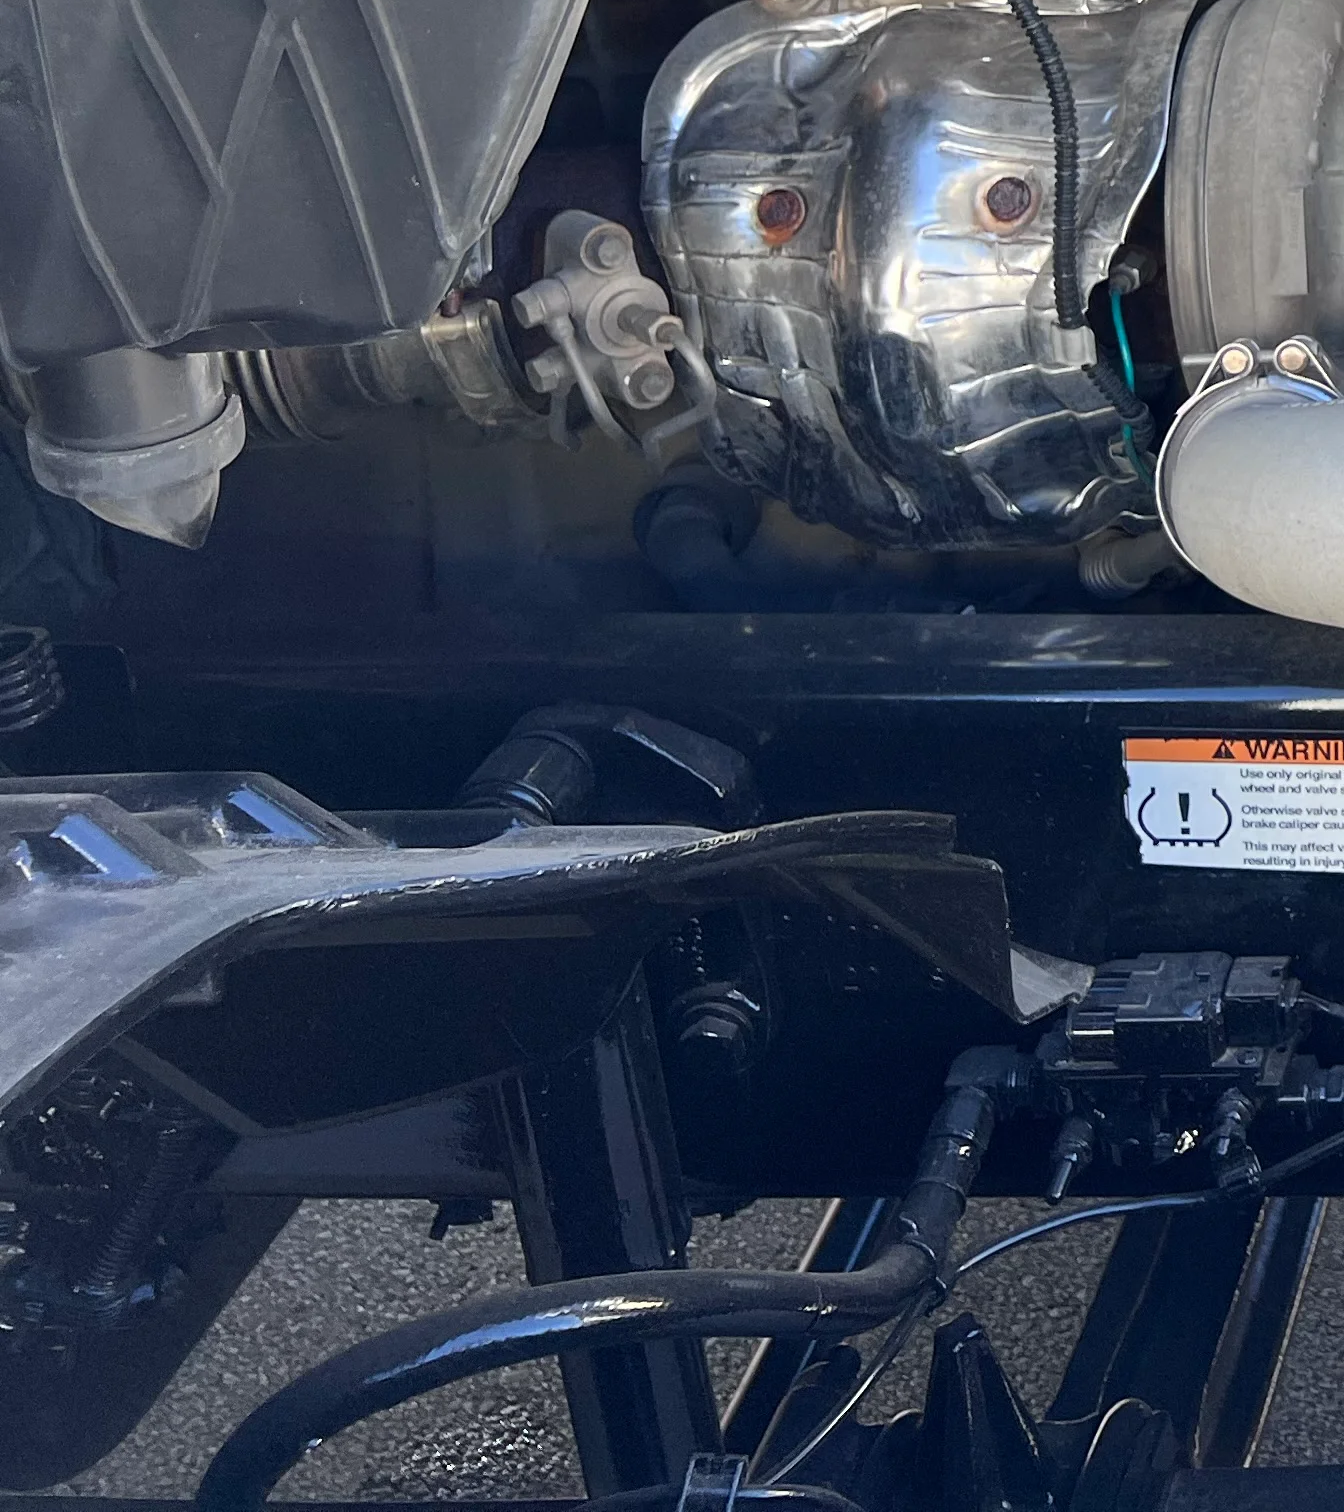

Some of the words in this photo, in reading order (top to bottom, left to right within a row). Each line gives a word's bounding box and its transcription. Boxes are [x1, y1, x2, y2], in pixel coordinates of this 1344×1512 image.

[1239, 768, 1264, 780] Use
[1266, 769, 1293, 782] only
[1295, 769, 1342, 783] original
[1240, 783, 1276, 793] wheel
[1278, 784, 1302, 794] and
[1304, 784, 1337, 795] valve
[1241, 804, 1303, 816] Otherwise
[1305, 806, 1338, 817] valve
[1241, 818, 1276, 830] brake
[1278, 819, 1320, 833] caliper
[1243, 840, 1269, 852] This
[1271, 842, 1298, 855] may
[1300, 841, 1335, 853] affect
[1243, 856, 1296, 870] resulting
[1299, 856, 1311, 867] in
